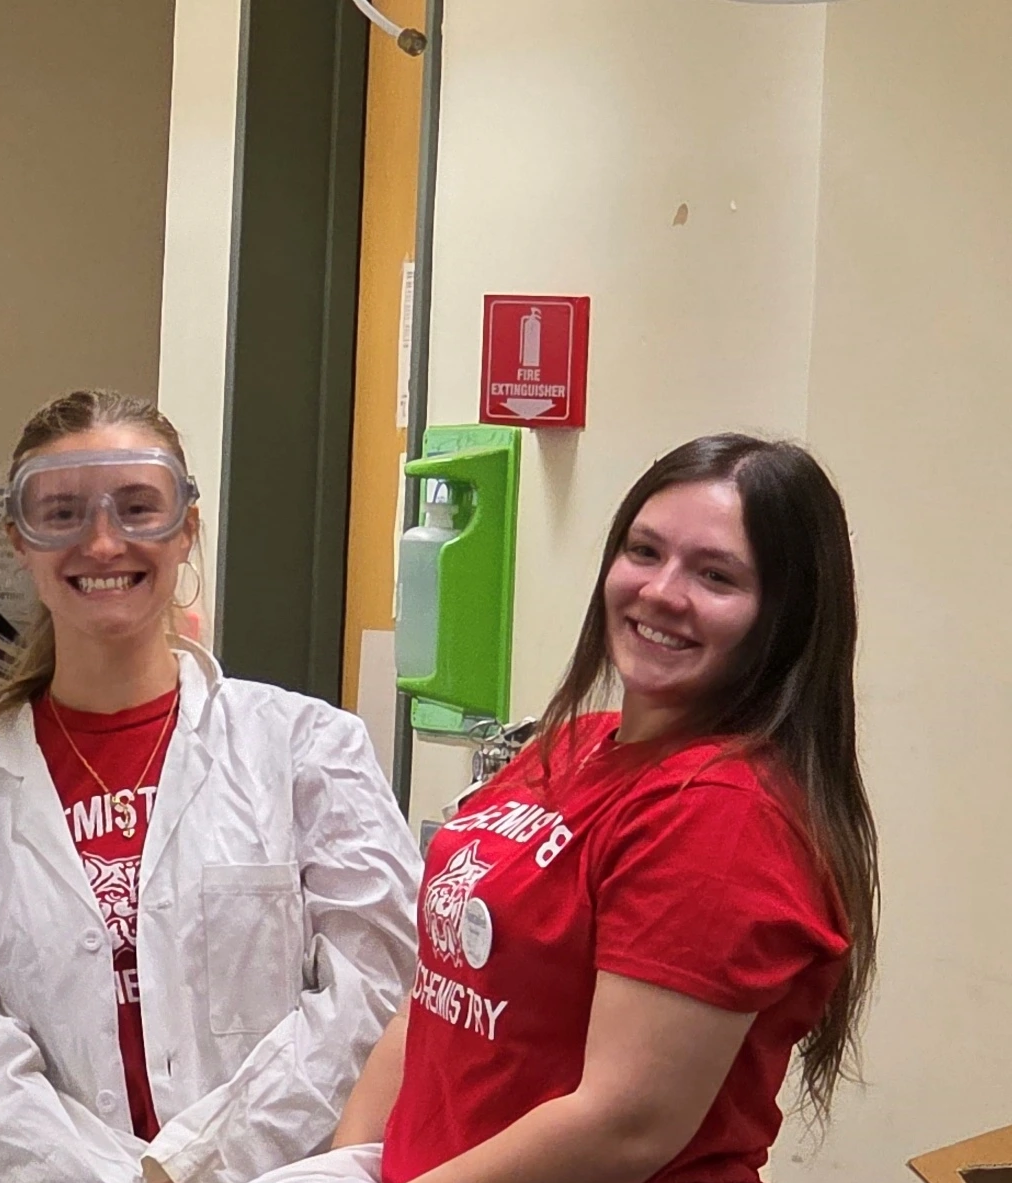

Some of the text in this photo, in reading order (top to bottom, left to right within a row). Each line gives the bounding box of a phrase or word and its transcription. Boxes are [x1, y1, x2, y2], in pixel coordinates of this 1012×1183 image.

[517, 368, 541, 382] FIRE
[491, 383, 566, 398] EXTINGUISHER
[412, 959, 508, 1041] CHEMISTRY
